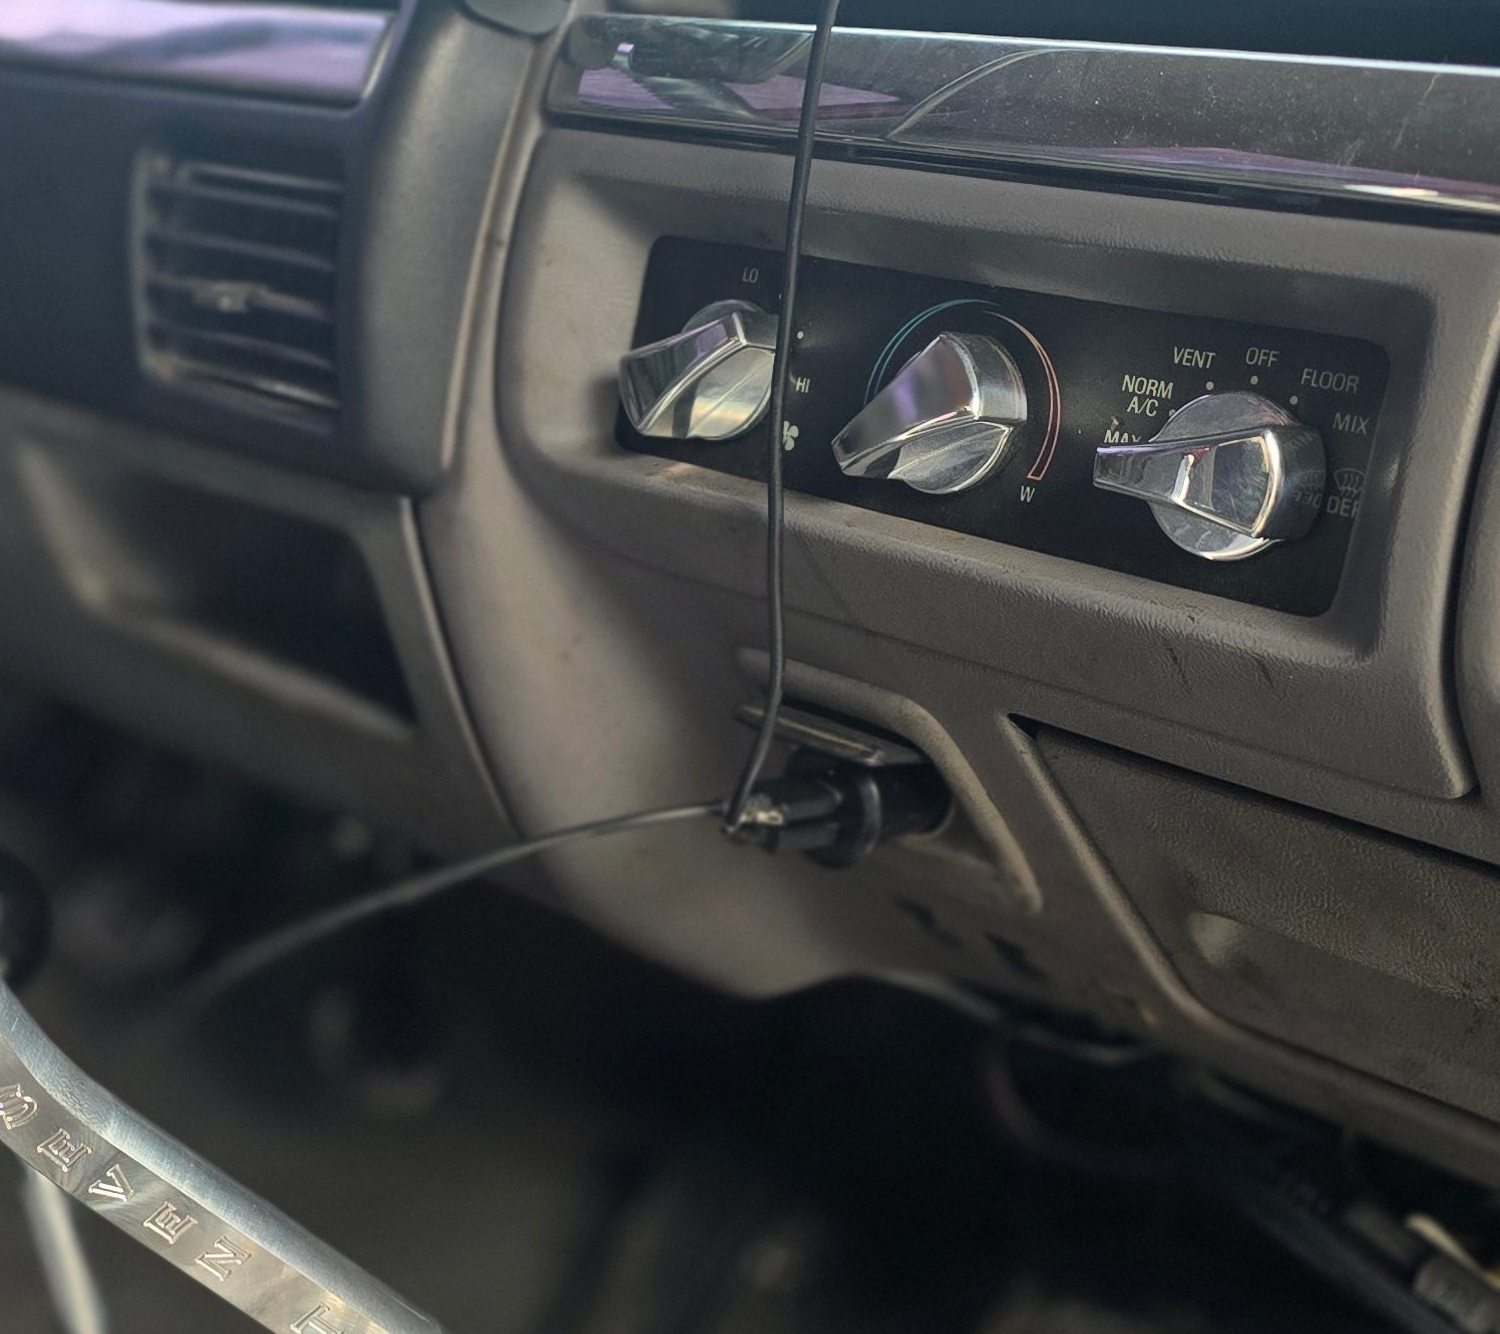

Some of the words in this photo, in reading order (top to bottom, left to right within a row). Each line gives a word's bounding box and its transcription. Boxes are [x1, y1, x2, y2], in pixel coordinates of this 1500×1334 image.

[742, 266, 760, 284] LO
[1172, 346, 1217, 370] VENT
[1245, 346, 1281, 367] OFF
[795, 376, 811, 394] HI
[1121, 374, 1174, 400] NORM
[1300, 368, 1360, 394] FLOOR
[1126, 397, 1159, 417] A/C
[1332, 412, 1370, 435] MIX
[1019, 485, 1036, 504] W
